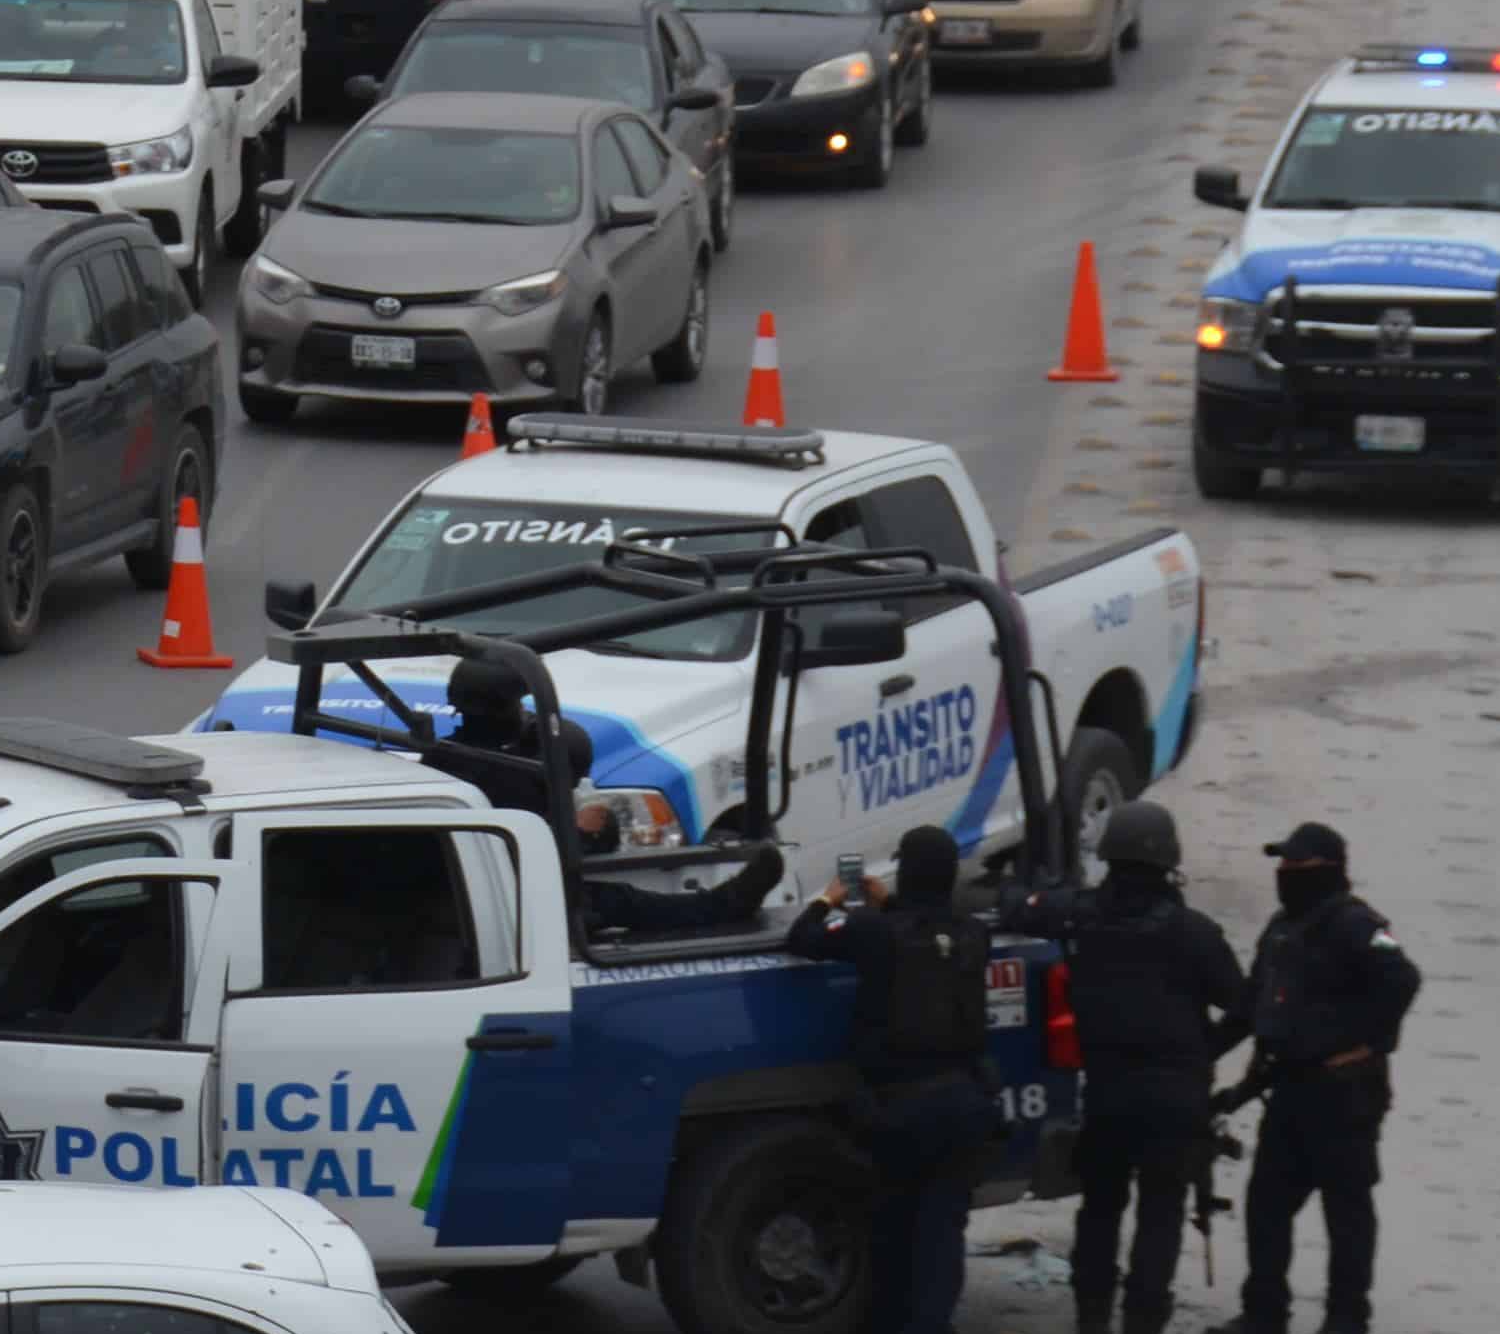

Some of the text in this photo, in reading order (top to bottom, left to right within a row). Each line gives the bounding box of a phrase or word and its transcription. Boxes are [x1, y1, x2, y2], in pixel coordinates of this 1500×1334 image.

[836, 683, 976, 775] TRÁNSITO
[858, 733, 976, 812] VIALIDAD
[221, 1070, 417, 1133] ICÍA
[55, 1125, 196, 1189] POL
